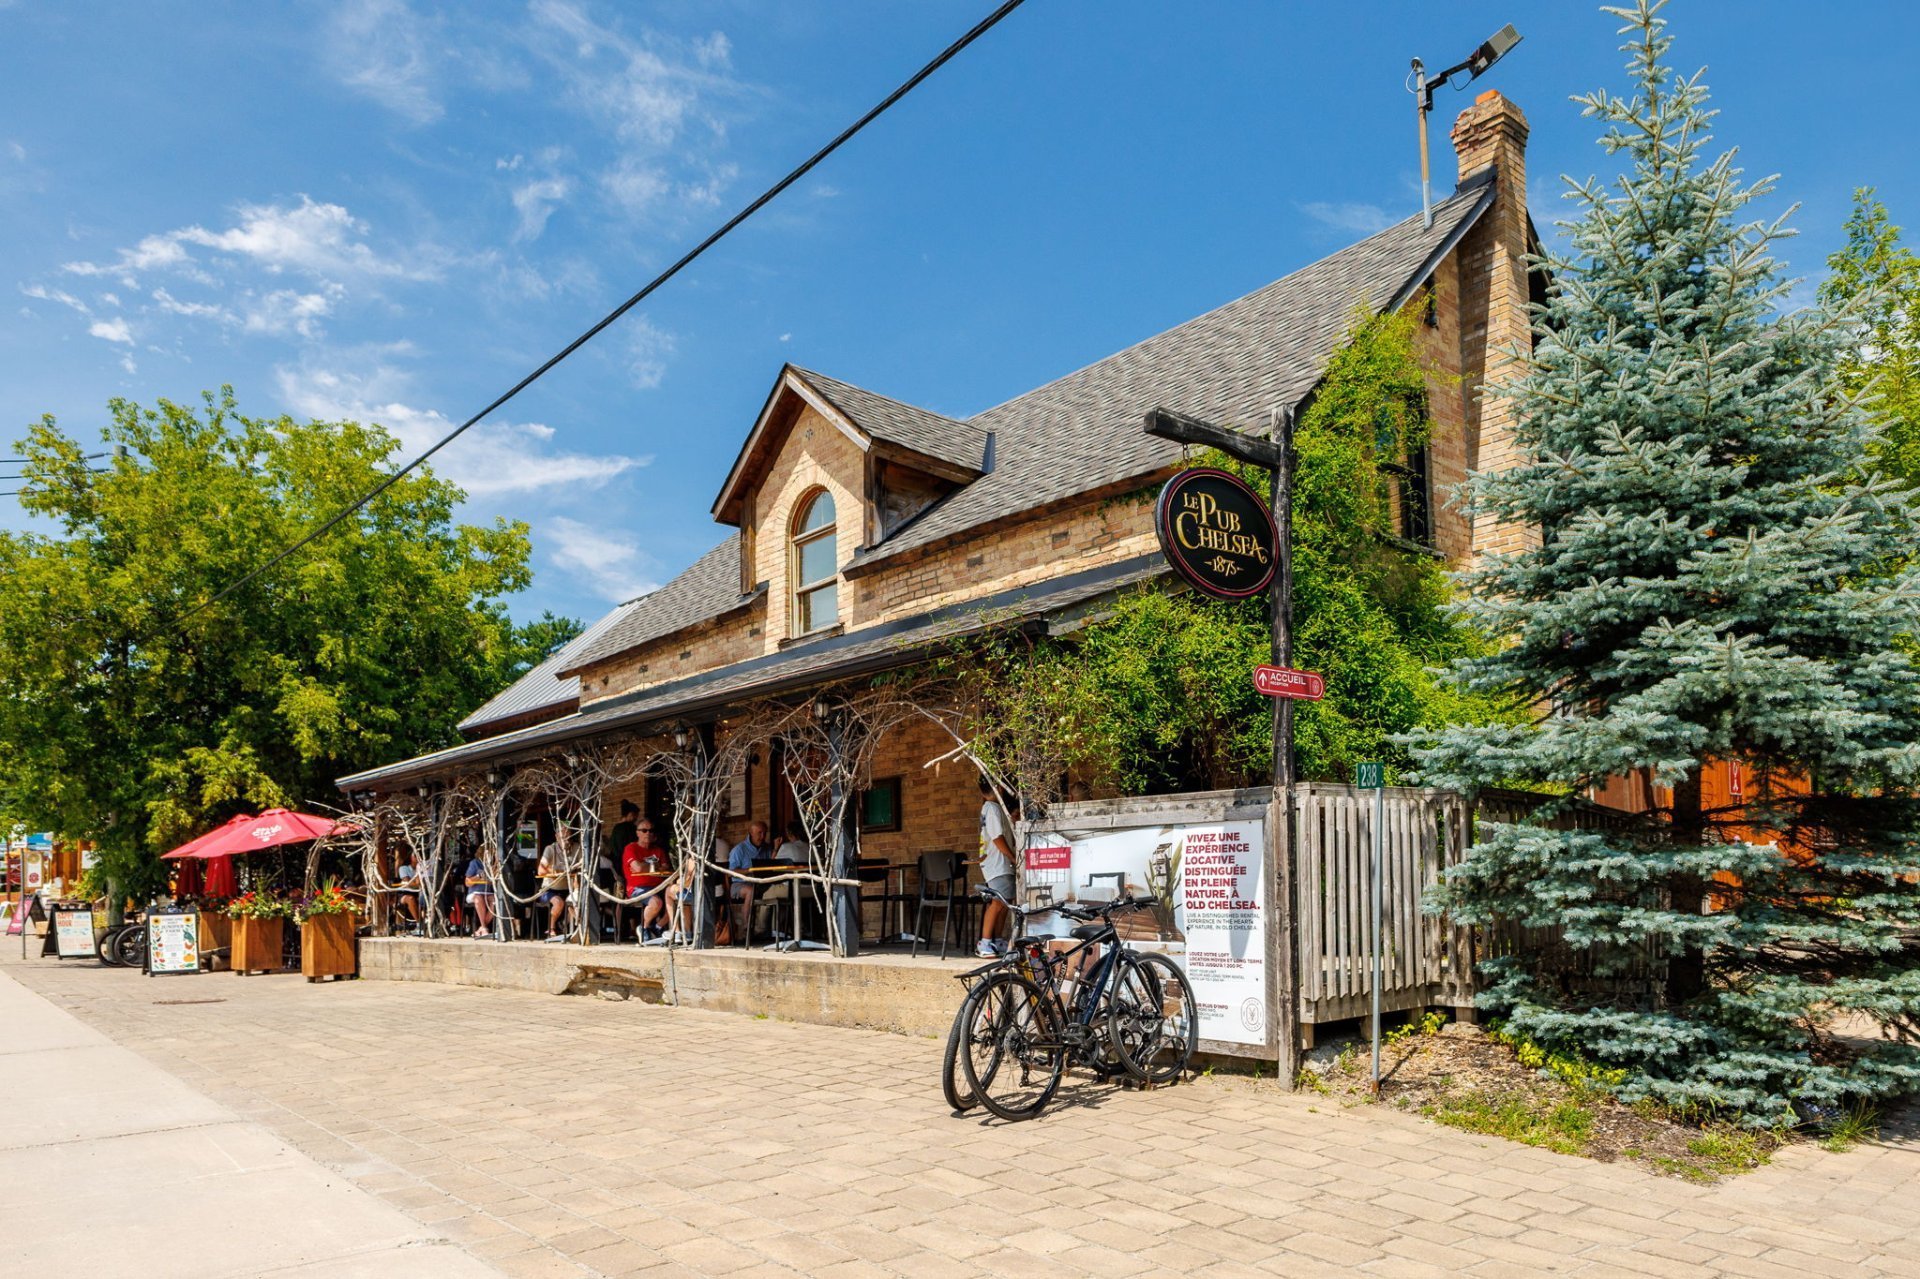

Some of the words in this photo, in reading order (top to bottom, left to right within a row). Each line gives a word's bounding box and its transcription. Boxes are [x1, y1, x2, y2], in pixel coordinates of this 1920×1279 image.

[1270, 672, 1306, 685] ACCUEIL
[1361, 764, 1377, 786] 238
[1187, 834, 1216, 843] VIVEZ
[1219, 832, 1240, 842] UNE
[1186, 842, 1250, 854] EXPÉRIENCE
[1185, 856, 1235, 865] LOCATIVE
[1185, 864, 1246, 876] DISTINGUÉE
[1185, 878, 1198, 887] EN
[1201, 878, 1238, 886] PLEINE
[1186, 890, 1228, 900] NATURE,
[1231, 887, 1240, 898] À
[1186, 901, 1206, 910] OLD
[1208, 900, 1260, 910] CHELSEA.
